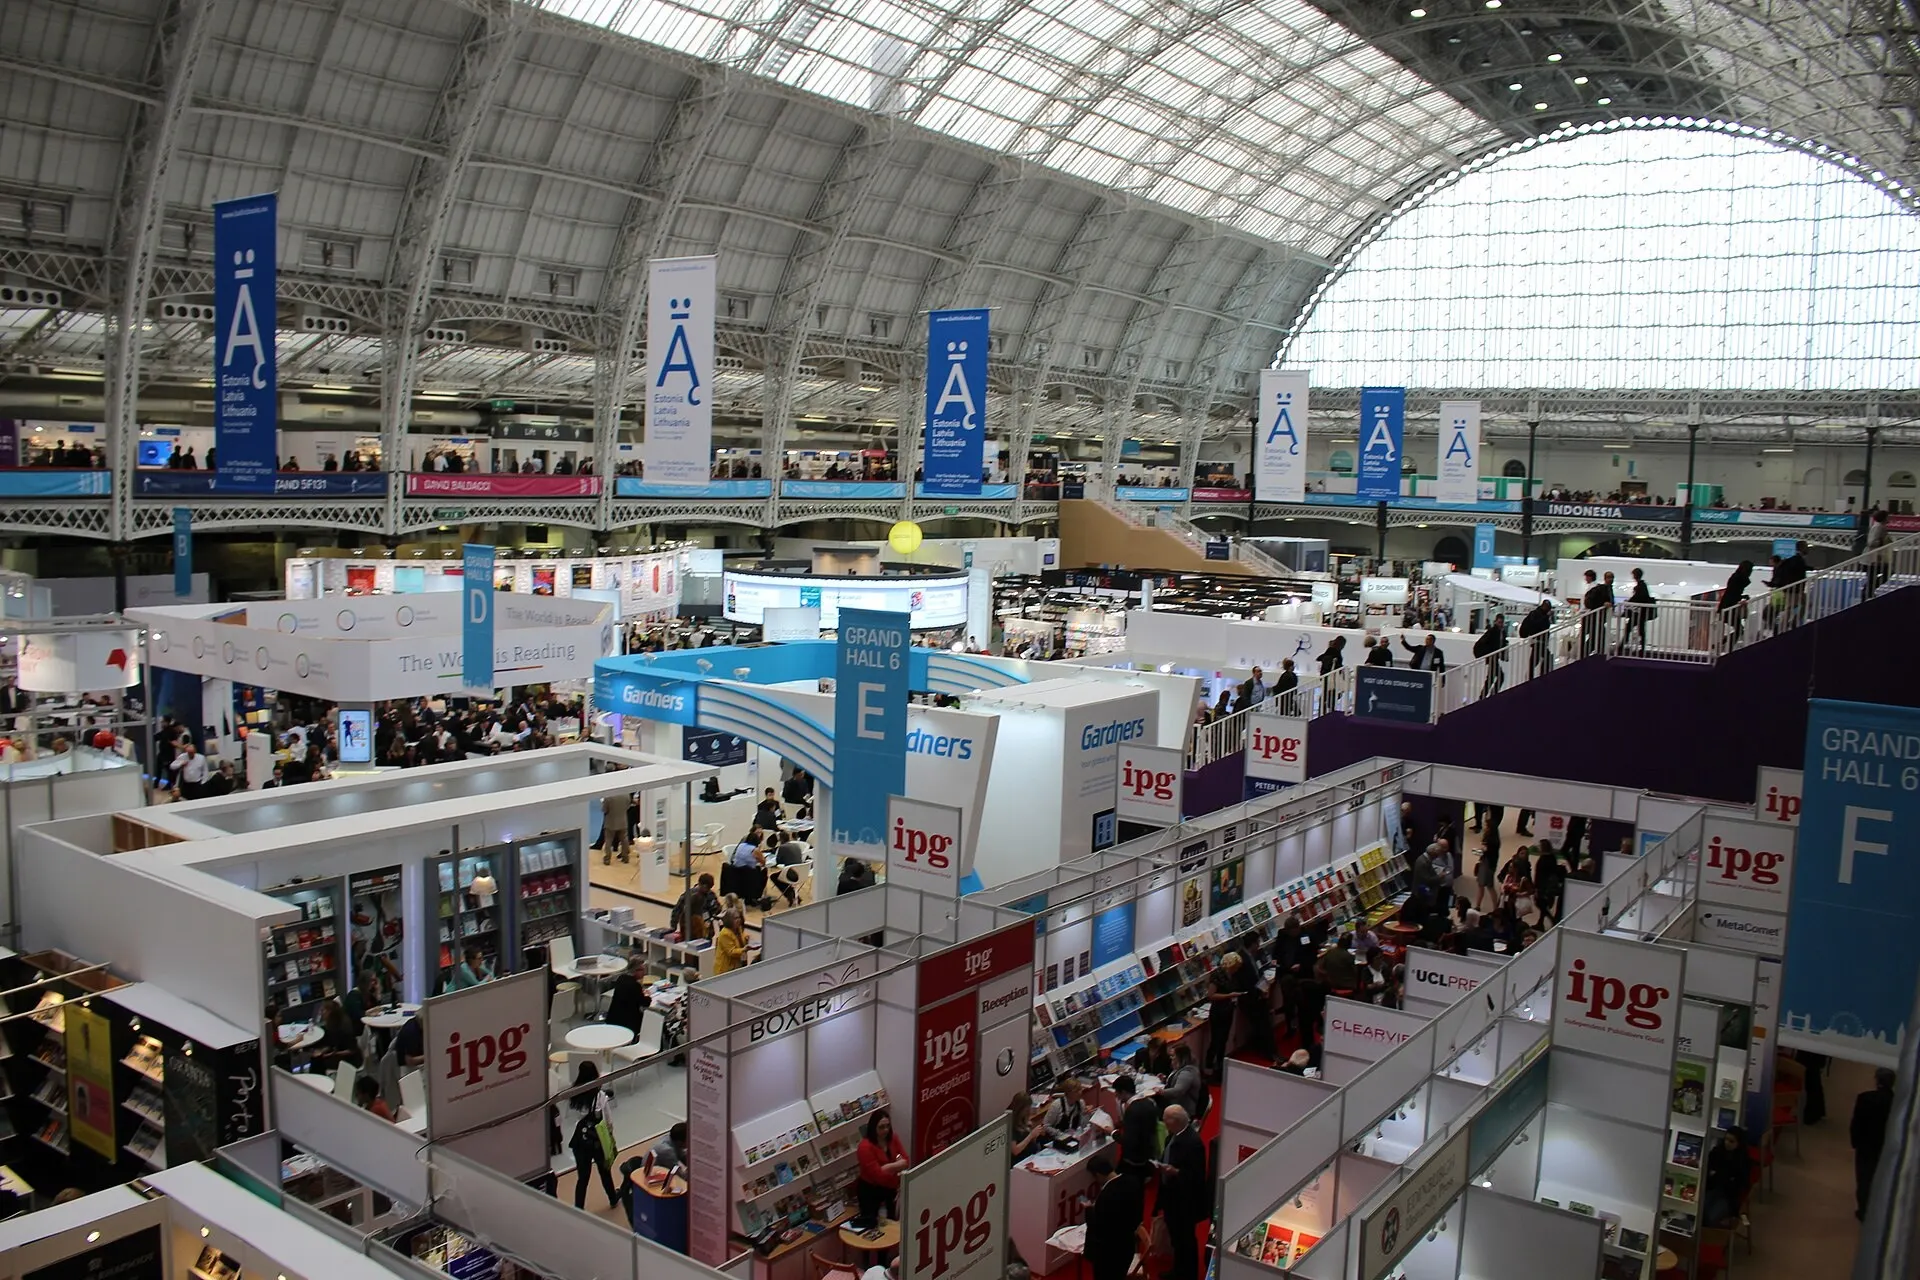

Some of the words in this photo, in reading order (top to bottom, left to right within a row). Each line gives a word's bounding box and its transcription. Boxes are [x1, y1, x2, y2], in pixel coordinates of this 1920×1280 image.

[222, 374, 250, 387] Estonia
[222, 388, 245, 402] Latvia
[654, 393, 684, 404] Estonia
[222, 403, 257, 417] Lithuania
[654, 405, 677, 415] Latvia
[654, 416, 690, 427] Lithuania
[932, 419, 960, 428] Estonia
[932, 429, 955, 437] Latvia
[932, 438, 966, 447] Lithuania
[275, 479, 299, 490] TAND
[424, 480, 450, 490] DAVID
[451, 480, 491, 491] BALDACCI
[1548, 503, 1622, 519] INDONESIA
[177, 535, 188, 556] B
[1479, 540, 1491, 553] D
[466, 556, 491, 568] GRAND
[470, 589, 488, 624] D
[505, 607, 523, 620] The
[524, 609, 554, 623] World
[845, 626, 903, 649] GRAND
[399, 654, 433, 673] The
[496, 649, 508, 664] is
[513, 643, 576, 662] Reading
[845, 647, 885, 669] HALL
[889, 651, 901, 671] 6
[622, 684, 685, 712] Gardners
[856, 682, 886, 741] E
[905, 728, 973, 760] dners
[1081, 717, 1145, 751] Gardners
[1252, 727, 1301, 762] ipg
[1821, 727, 1920, 762] GRAND
[1122, 760, 1177, 800] ipg
[1255, 782, 1276, 791] PETER
[1821, 756, 1892, 789] HALL
[1900, 766, 1919, 792] 6
[1765, 786, 1803, 822] ip
[893, 817, 953, 869] ipg
[1837, 805, 1894, 885] F
[1707, 835, 1785, 886] ipg
[1716, 917, 1780, 937] MetaComet
[964, 946, 993, 975] ipg
[1415, 968, 1480, 993] UCLPRE
[756, 994, 784, 1012] ooks
[981, 984, 1029, 1014] Reception
[1566, 958, 1670, 1031] ipg
[1331, 1018, 1412, 1047] CLEARVIE
[1564, 1017, 1606, 1032] Independent
[1606, 1026, 1644, 1040] Publishers
[1644, 1034, 1666, 1044] Guild
[445, 1022, 531, 1087] ipg
[923, 1021, 971, 1070] ipg
[920, 1068, 971, 1102] Reception
[983, 1133, 1007, 1156] 6E70
[914, 1183, 997, 1280] ipg
